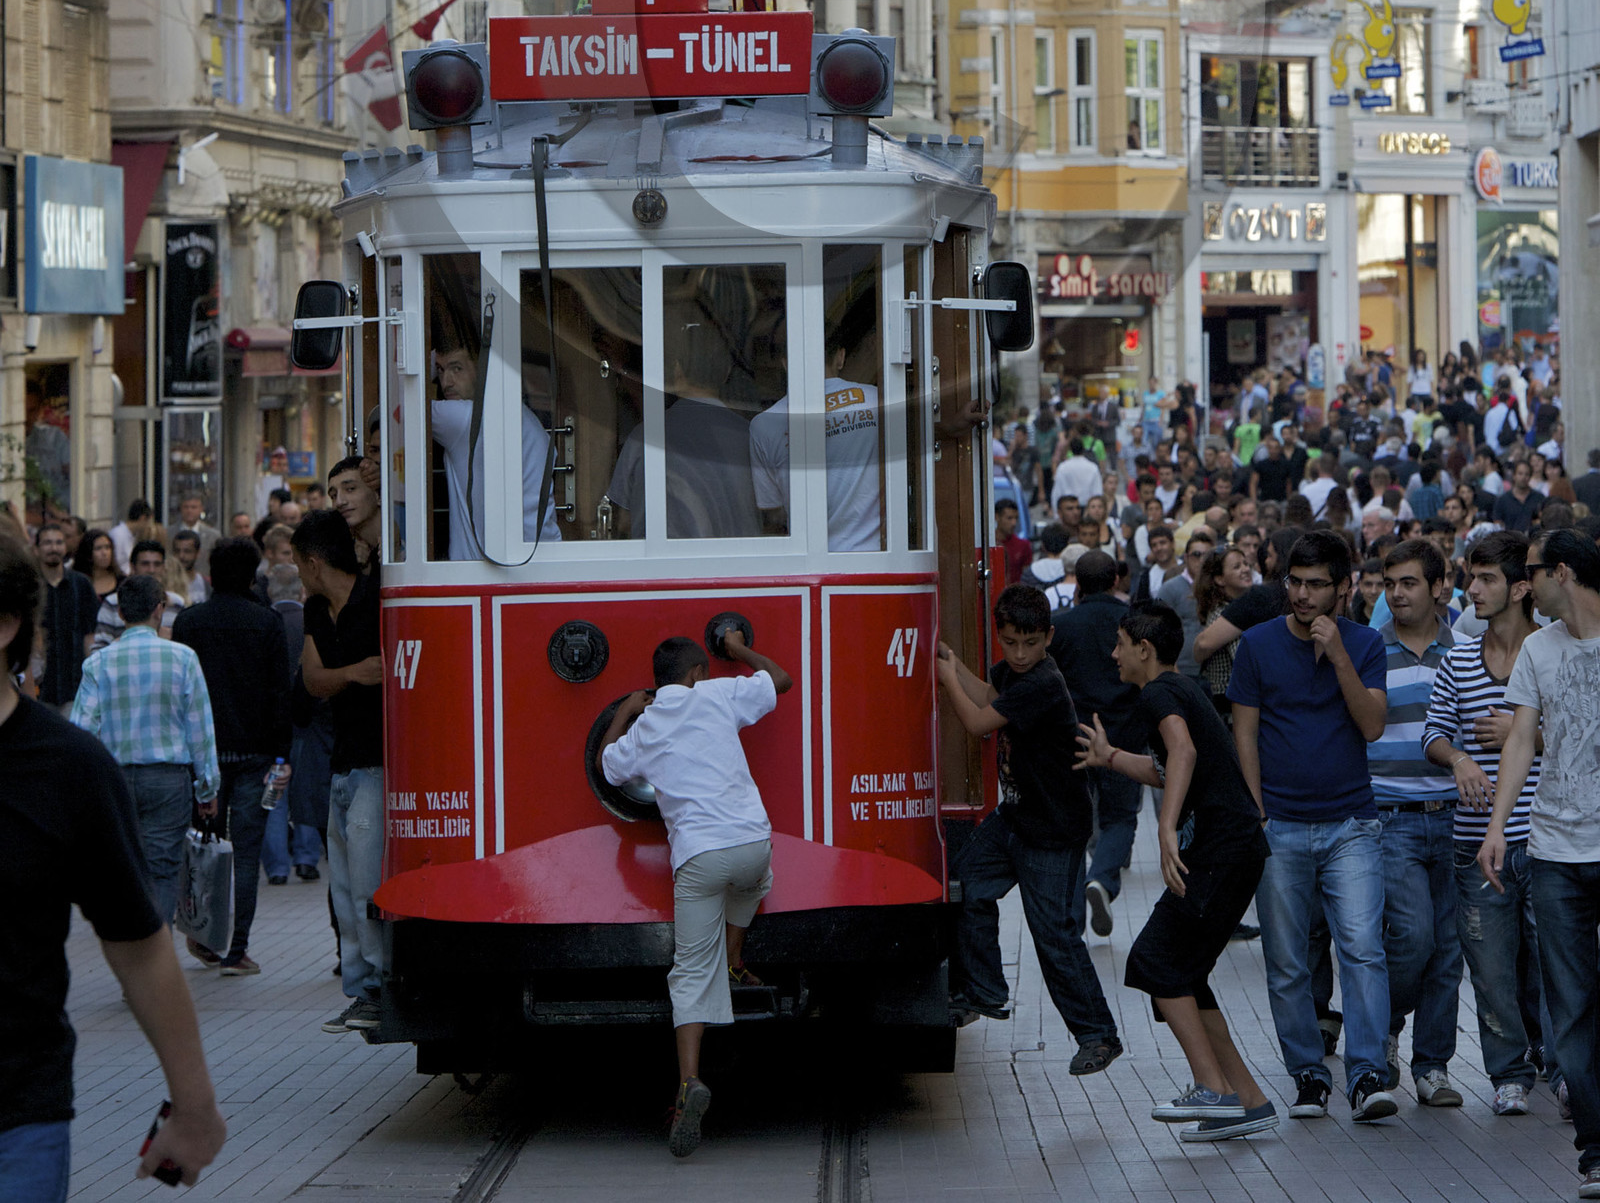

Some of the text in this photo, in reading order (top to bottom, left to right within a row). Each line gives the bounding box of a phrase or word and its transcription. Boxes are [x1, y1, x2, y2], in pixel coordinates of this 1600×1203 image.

[679, 24, 791, 73] TÜNEL
[842, 421, 877, 434] DIVISION
[886, 627, 918, 678] 47
[394, 639, 422, 689] 47
[850, 772, 906, 794] ASILMAK
[425, 791, 469, 810] YASAK
[850, 801, 870, 821] VE
